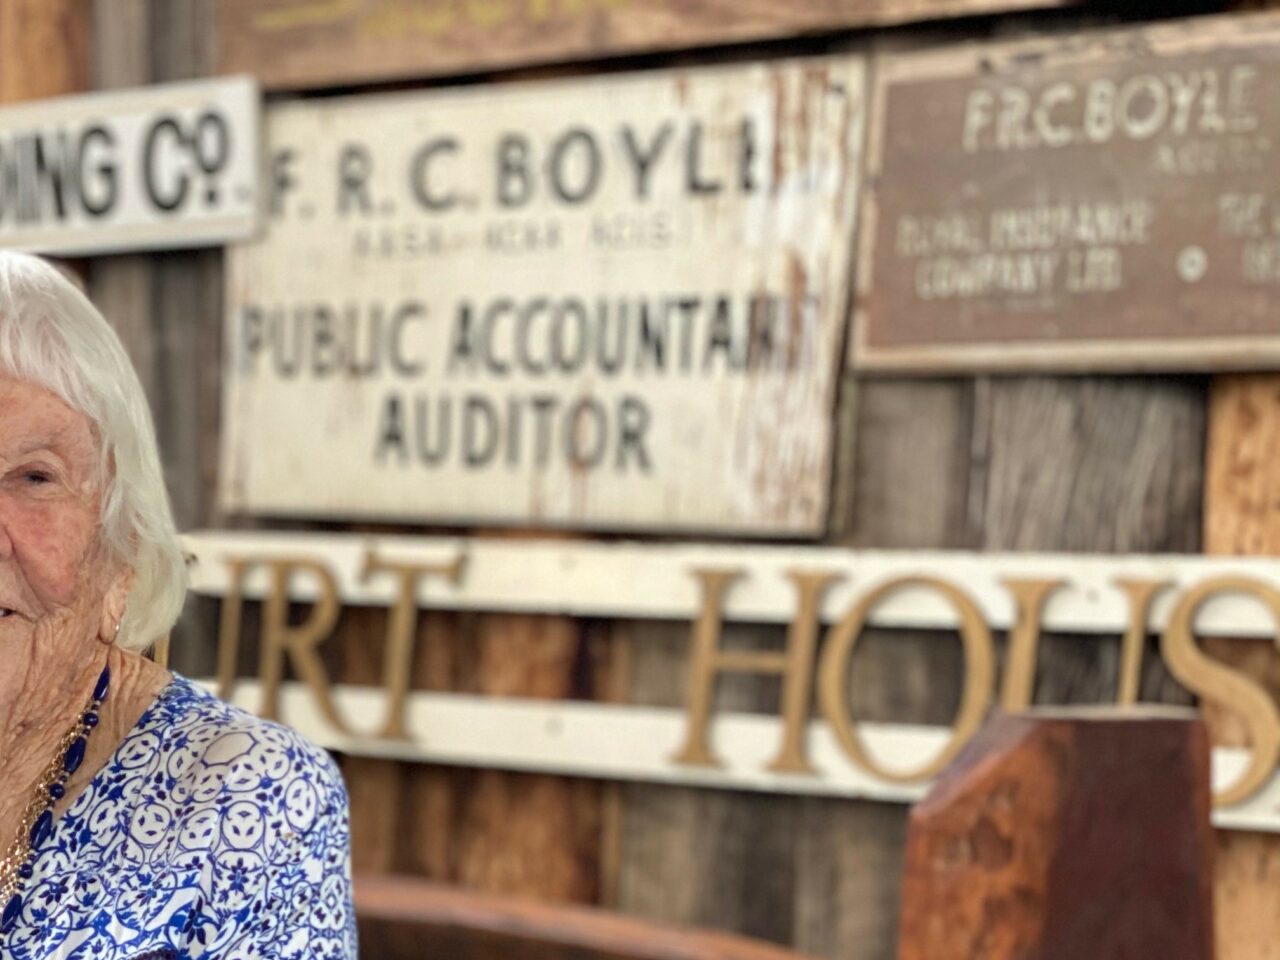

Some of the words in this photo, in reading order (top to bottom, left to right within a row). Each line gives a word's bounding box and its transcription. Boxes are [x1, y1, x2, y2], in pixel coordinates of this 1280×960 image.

[1084, 64, 1259, 144] BOYLE
[235, 299, 426, 380] PUBLIC
[373, 392, 654, 475] AUDITOR
